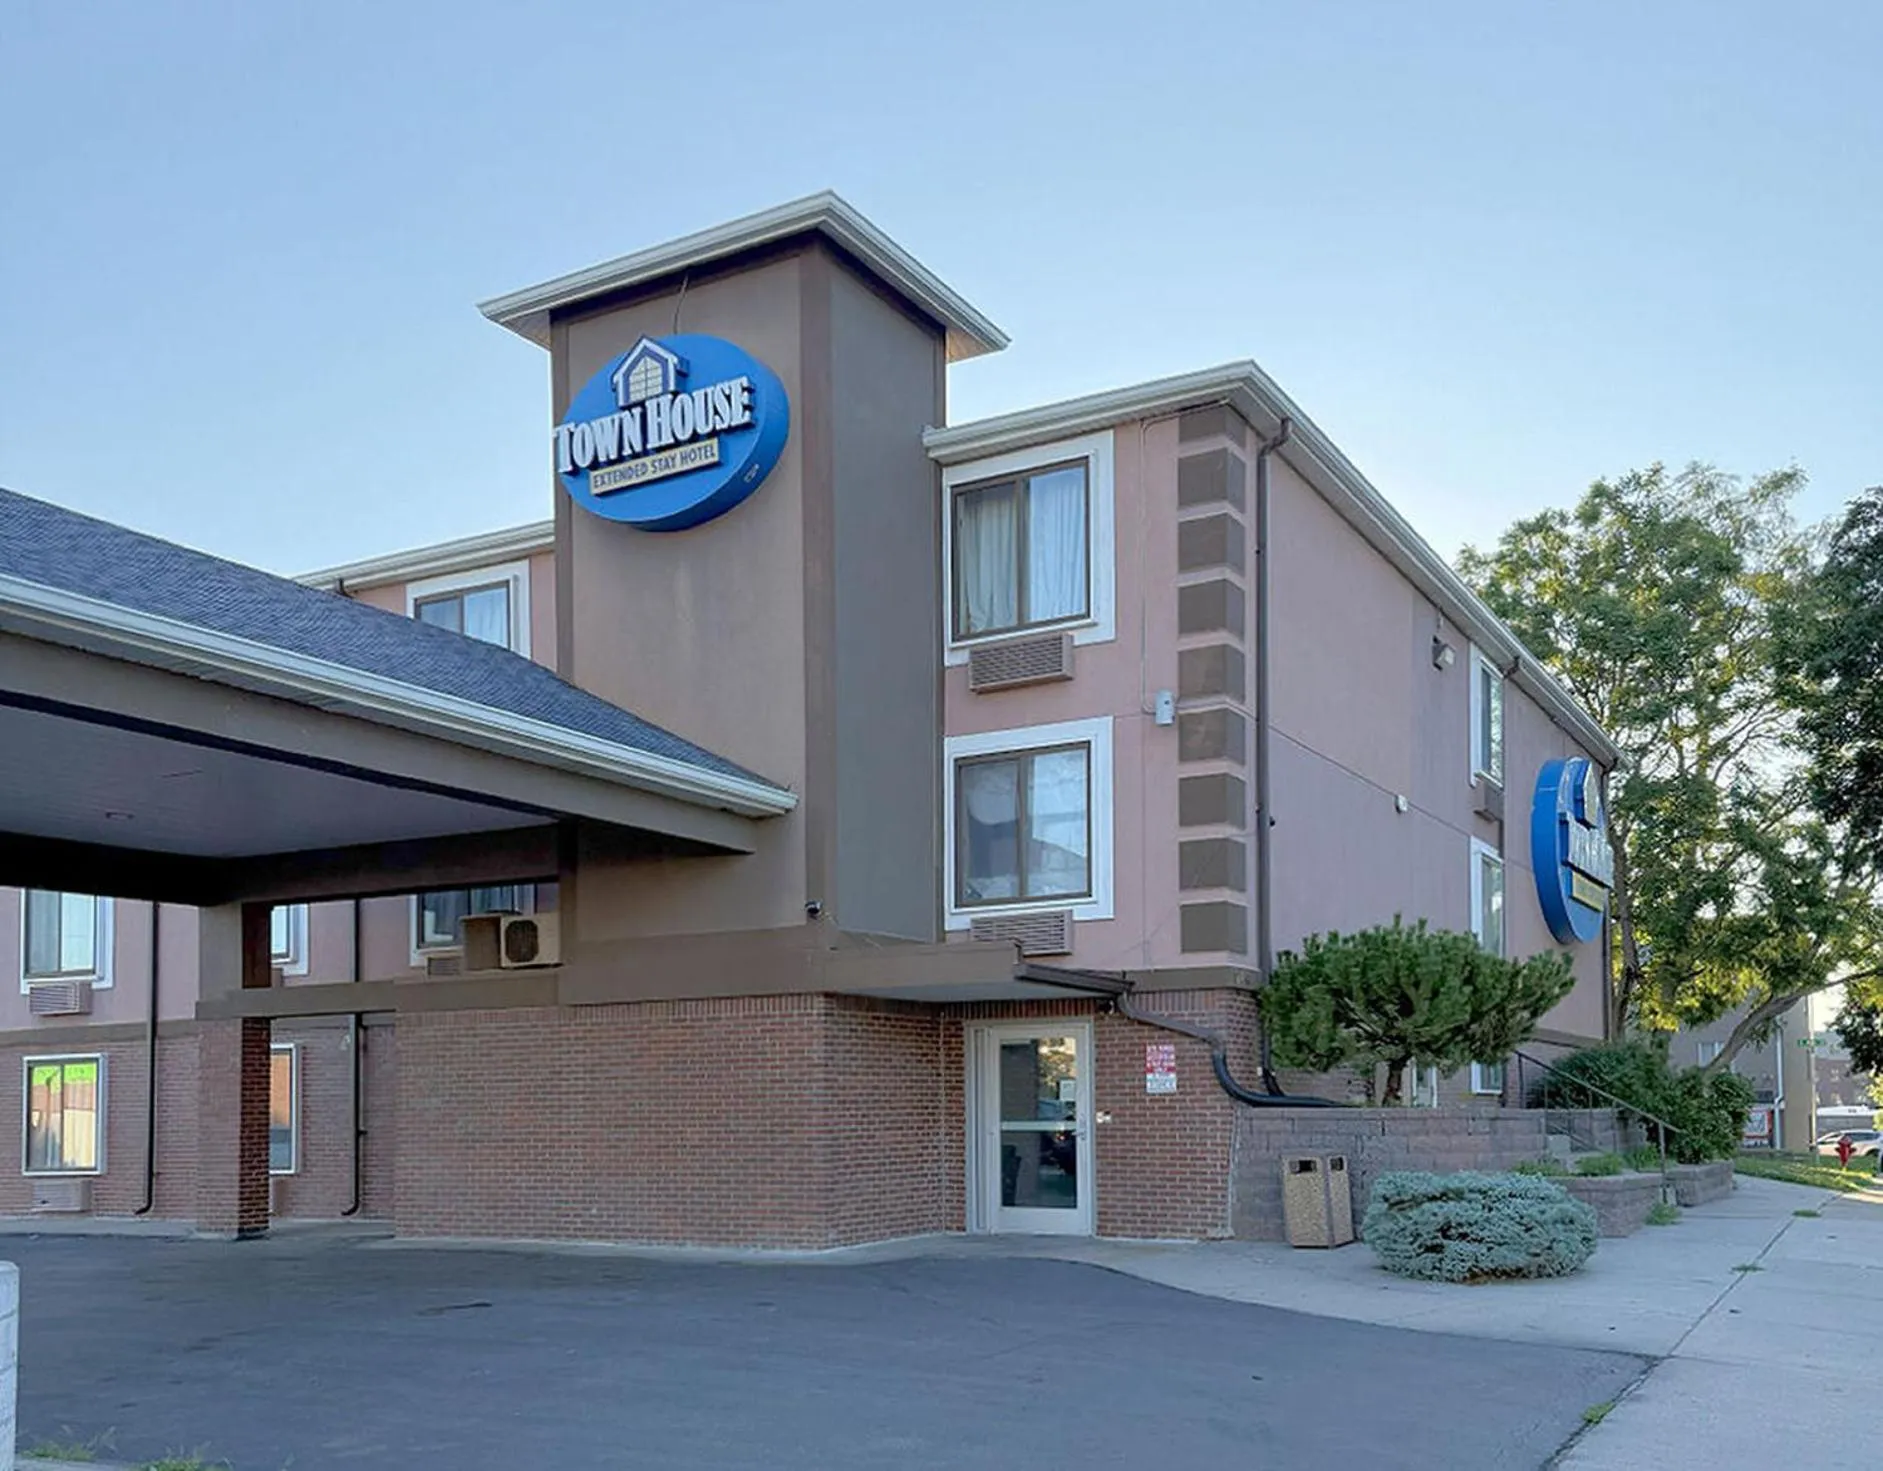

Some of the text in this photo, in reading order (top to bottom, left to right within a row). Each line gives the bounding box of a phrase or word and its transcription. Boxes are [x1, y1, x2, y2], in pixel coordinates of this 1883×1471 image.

[553, 377, 751, 473] TOWN HOUSE
[593, 444, 716, 489] EXTENDED STAY HOTEL
